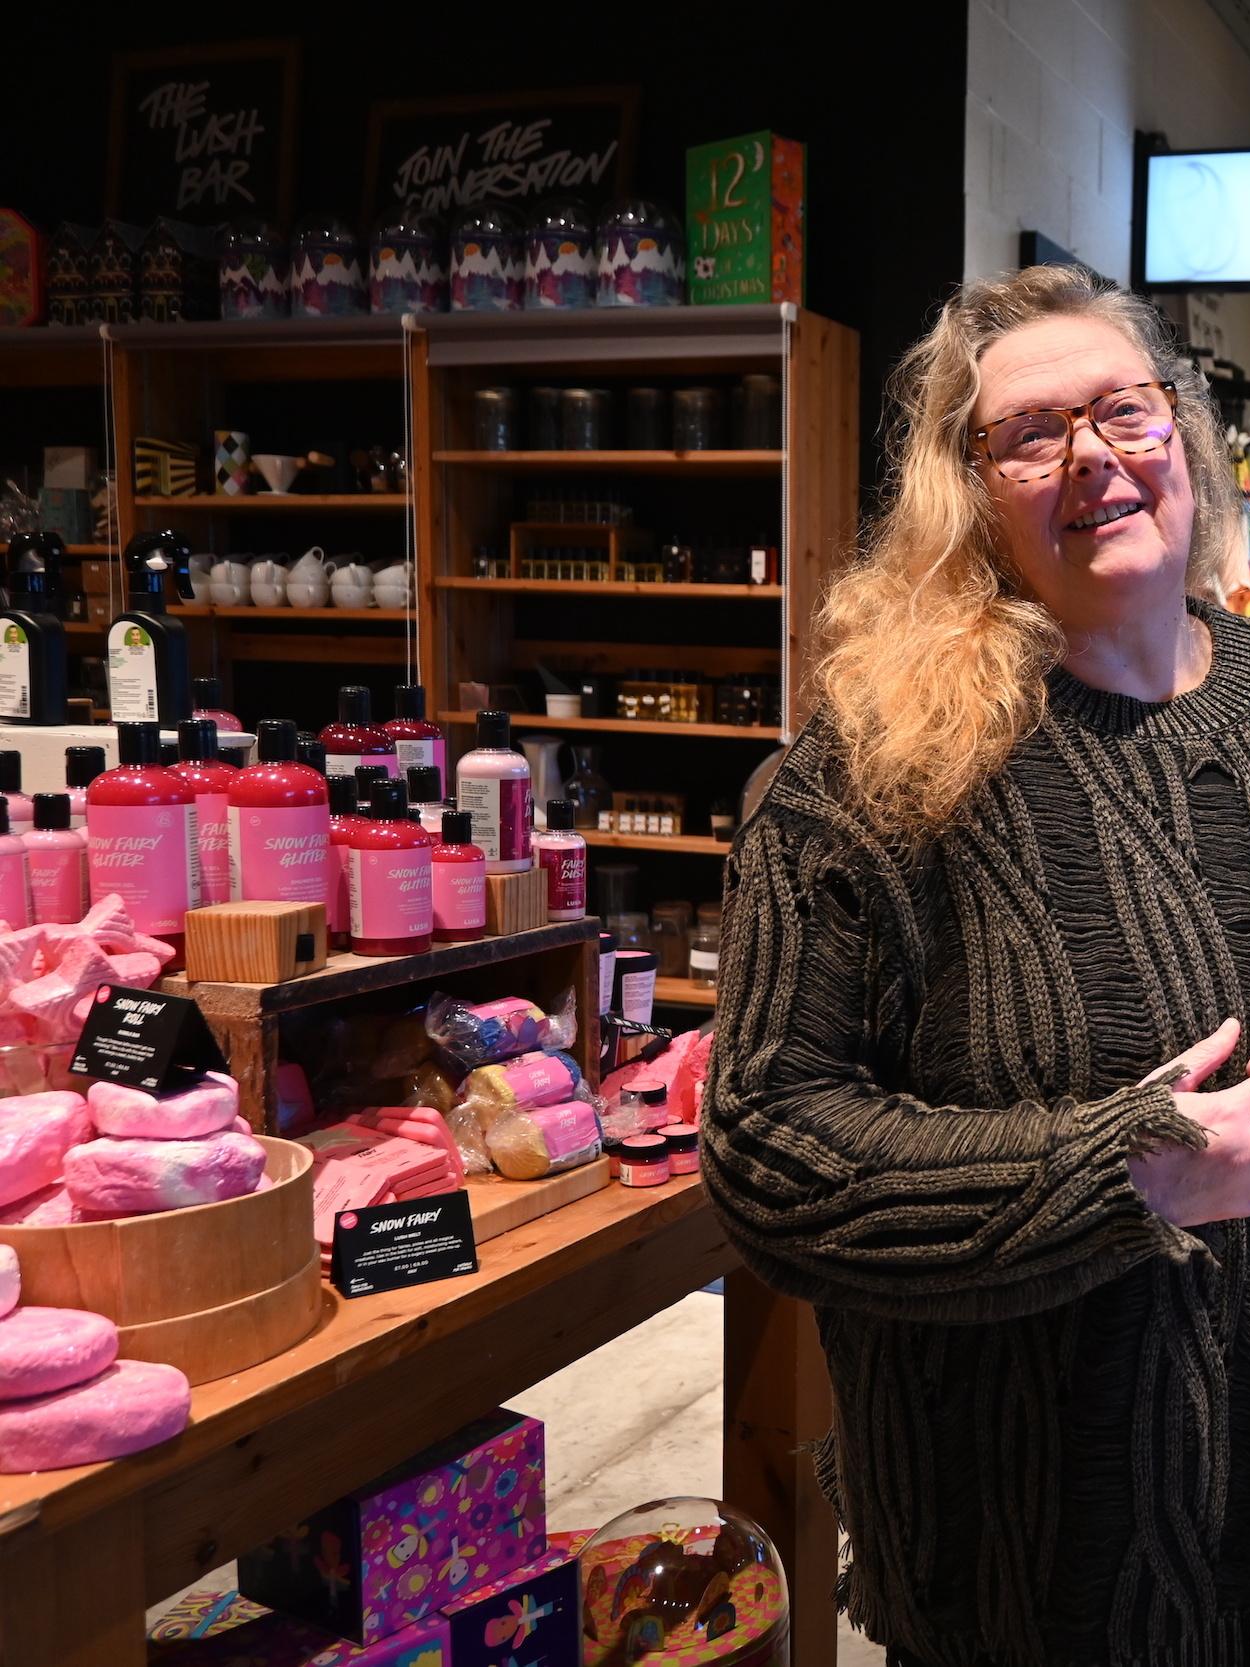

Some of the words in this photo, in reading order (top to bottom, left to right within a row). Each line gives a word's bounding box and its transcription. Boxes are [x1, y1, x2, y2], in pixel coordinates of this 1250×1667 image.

[139, 81, 210, 128] THE
[176, 109, 265, 162] LUSH
[393, 132, 470, 198] JOIN
[477, 118, 552, 162] THE
[176, 159, 256, 210] BAR
[709, 152, 747, 212] 12
[702, 218, 753, 251] DAYS
[88, 837, 113, 850] NOW
[115, 834, 164, 850] FAIRY
[263, 837, 309, 850] SNOW
[93, 853, 145, 866] GLITTER
[386, 867, 419, 879] SNOW
[409, 922, 429, 931] LUSH
[113, 998, 140, 1013] SNOW
[138, 1000, 167, 1016] FAIRY
[122, 1013, 145, 1025] ROLL
[369, 1217, 406, 1234] SNOW
[406, 1207, 443, 1228] FAIRY
